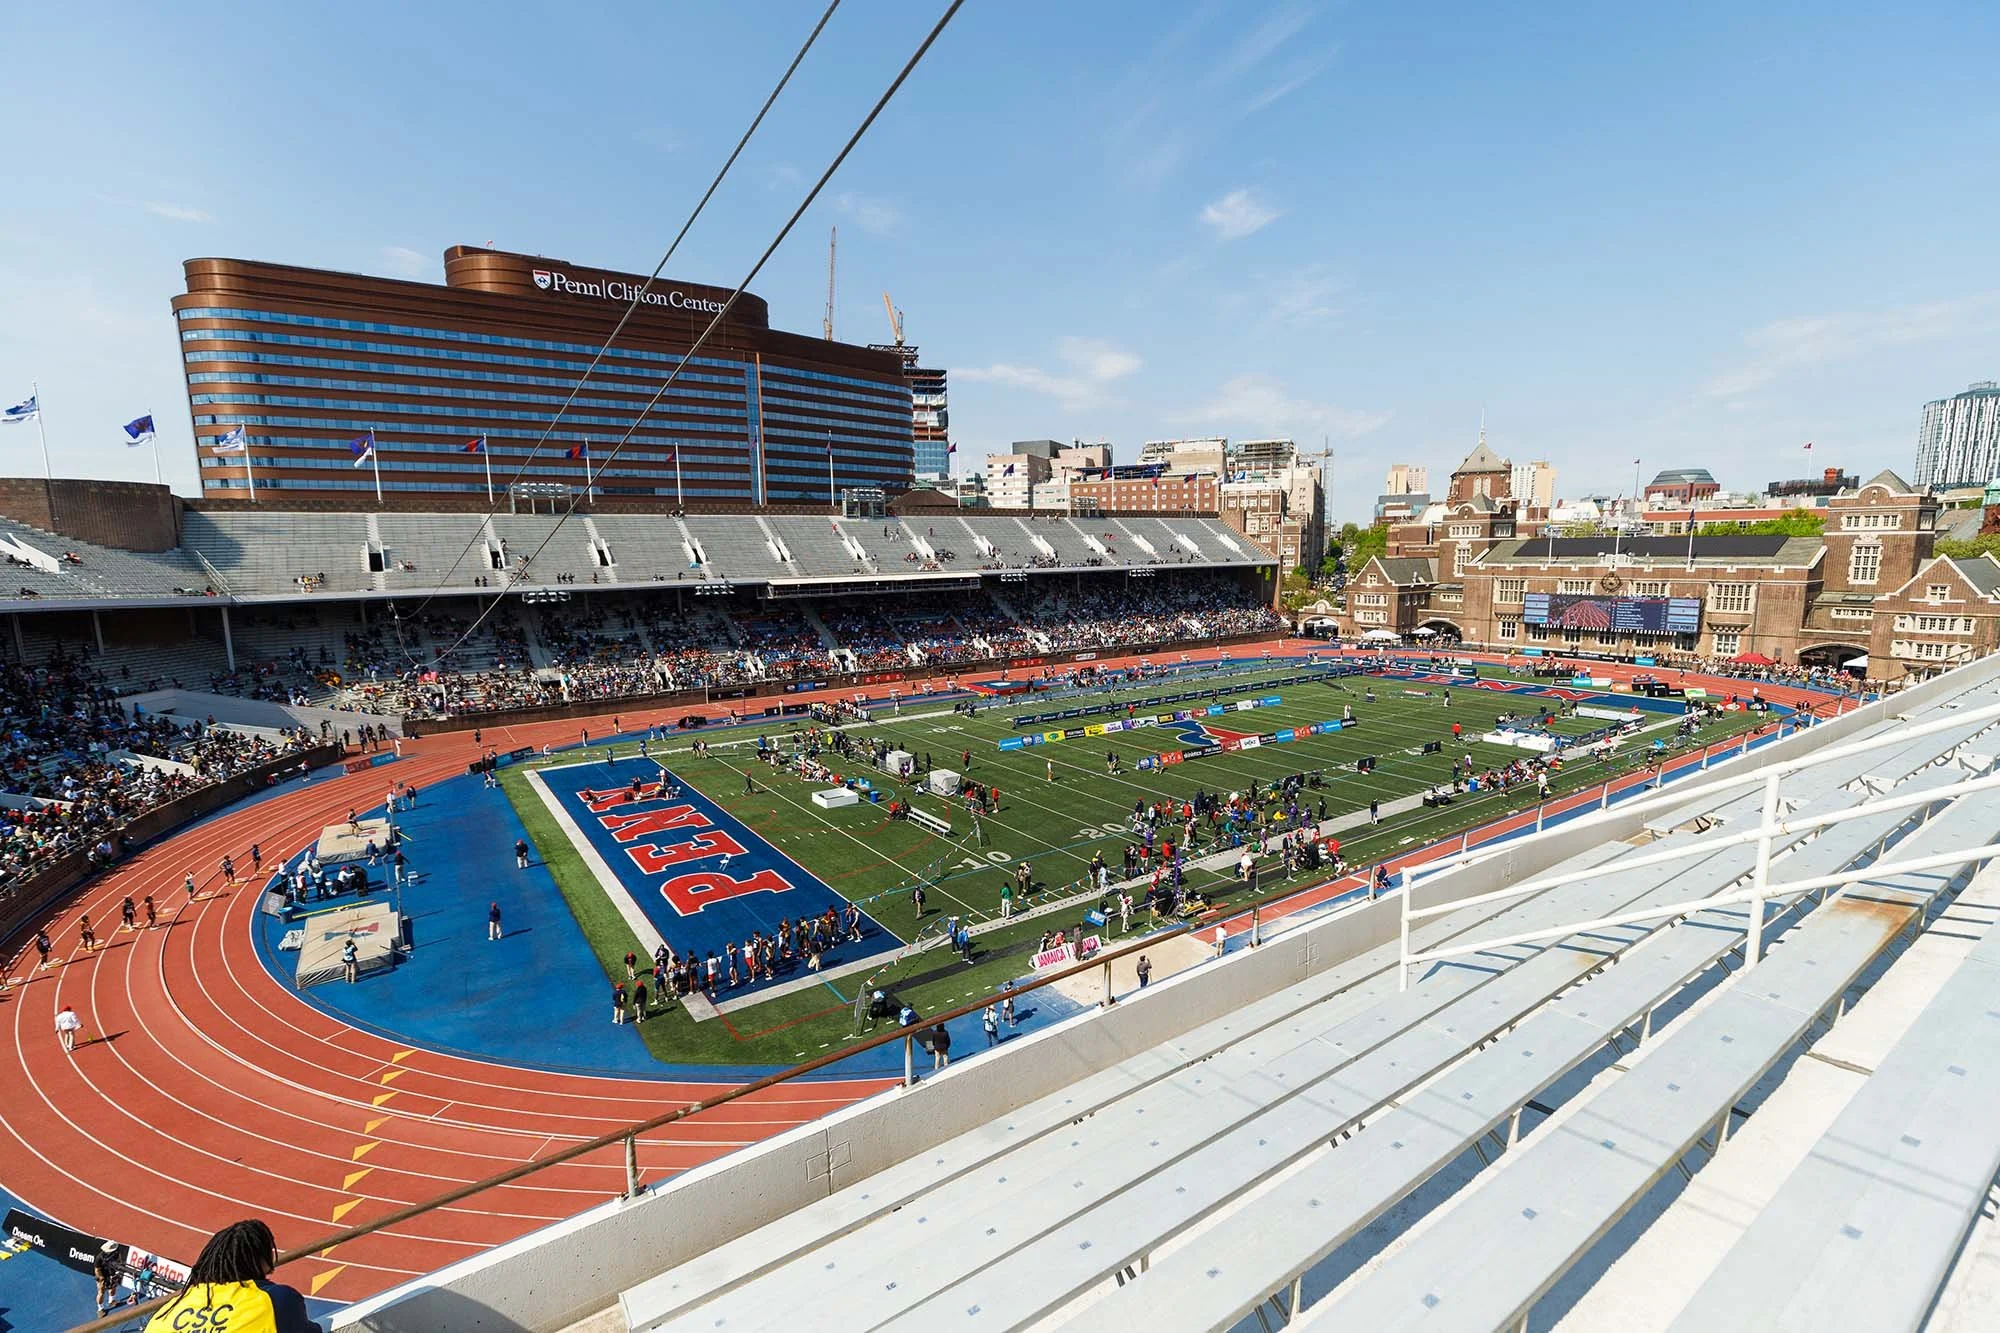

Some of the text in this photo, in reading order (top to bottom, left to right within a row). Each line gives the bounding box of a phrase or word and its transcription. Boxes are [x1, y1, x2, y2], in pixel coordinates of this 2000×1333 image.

[551, 271, 727, 313] Penn Clifton Center
[576, 782, 796, 917] PENN
[1038, 948, 1067, 968] JAMAICA
[69, 1247, 95, 1263] Dream
[173, 1304, 233, 1330] CSC
